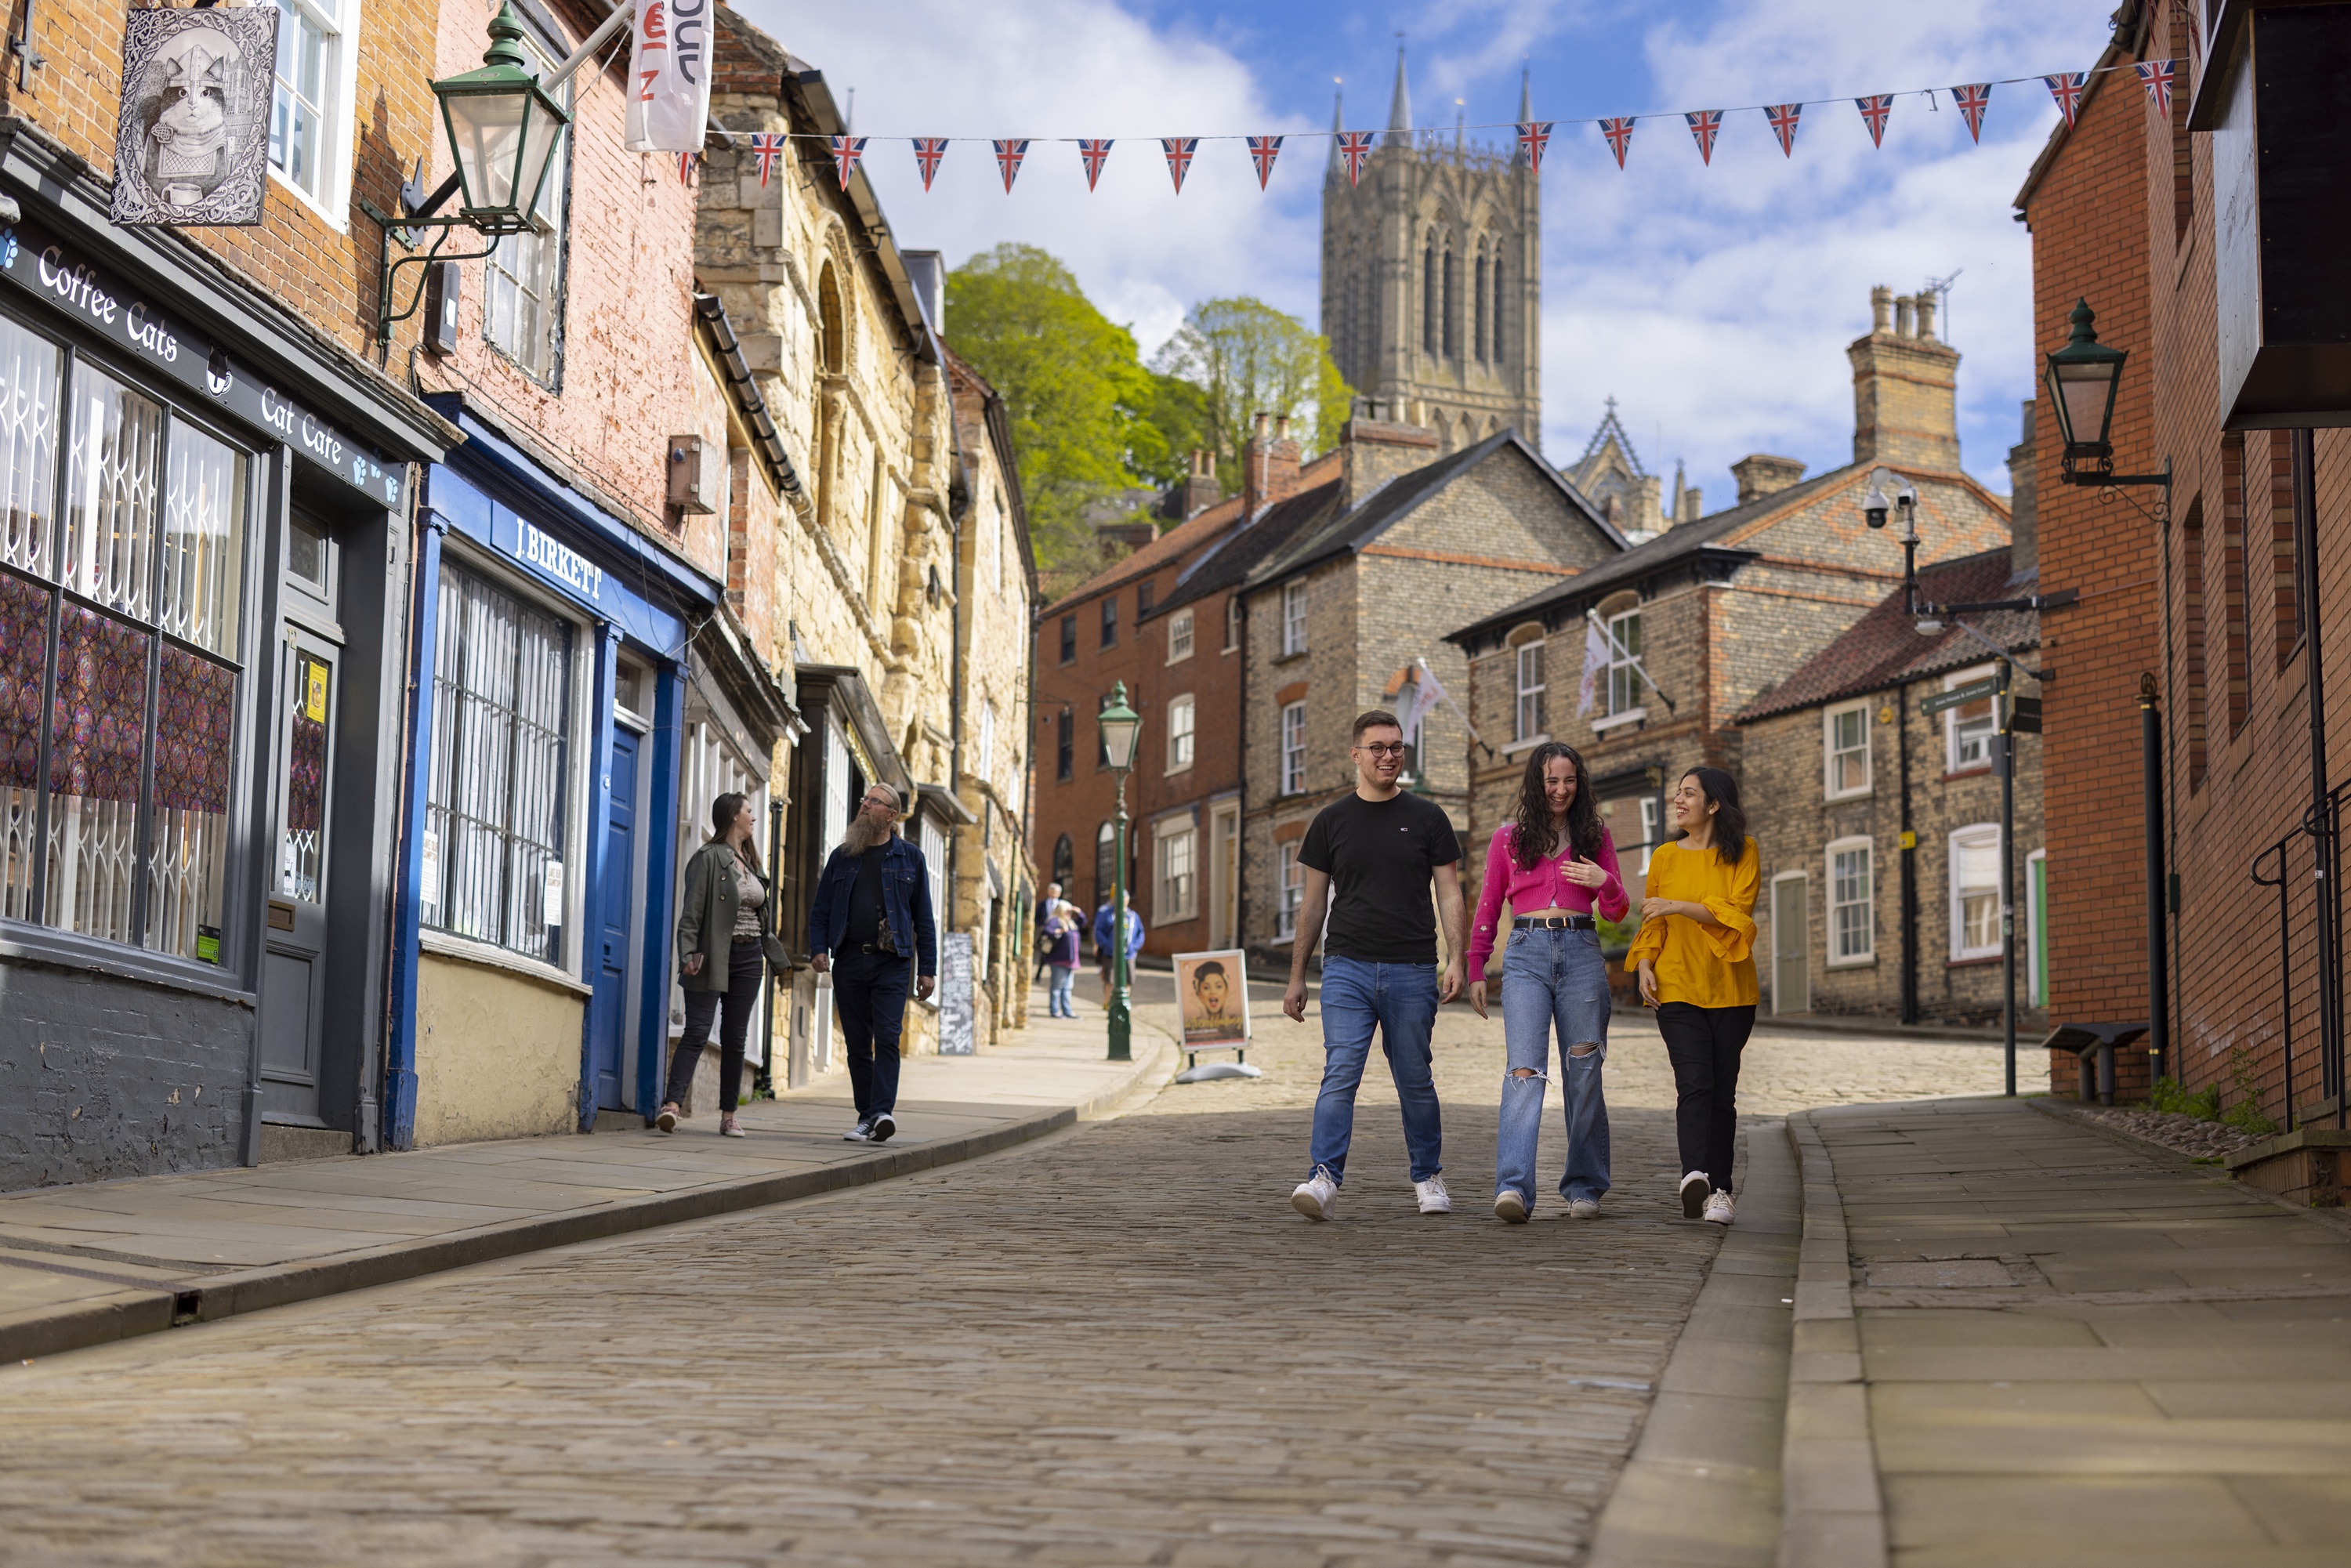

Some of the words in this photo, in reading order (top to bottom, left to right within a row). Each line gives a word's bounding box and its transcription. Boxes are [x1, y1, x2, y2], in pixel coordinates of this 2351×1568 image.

[39, 245, 117, 324] Coffee
[127, 302, 177, 362] Cats
[262, 386, 295, 435] Cat
[302, 412, 342, 465] Cafe
[527, 524, 602, 600] BIRKETT
[287, 627, 297, 650] 12
